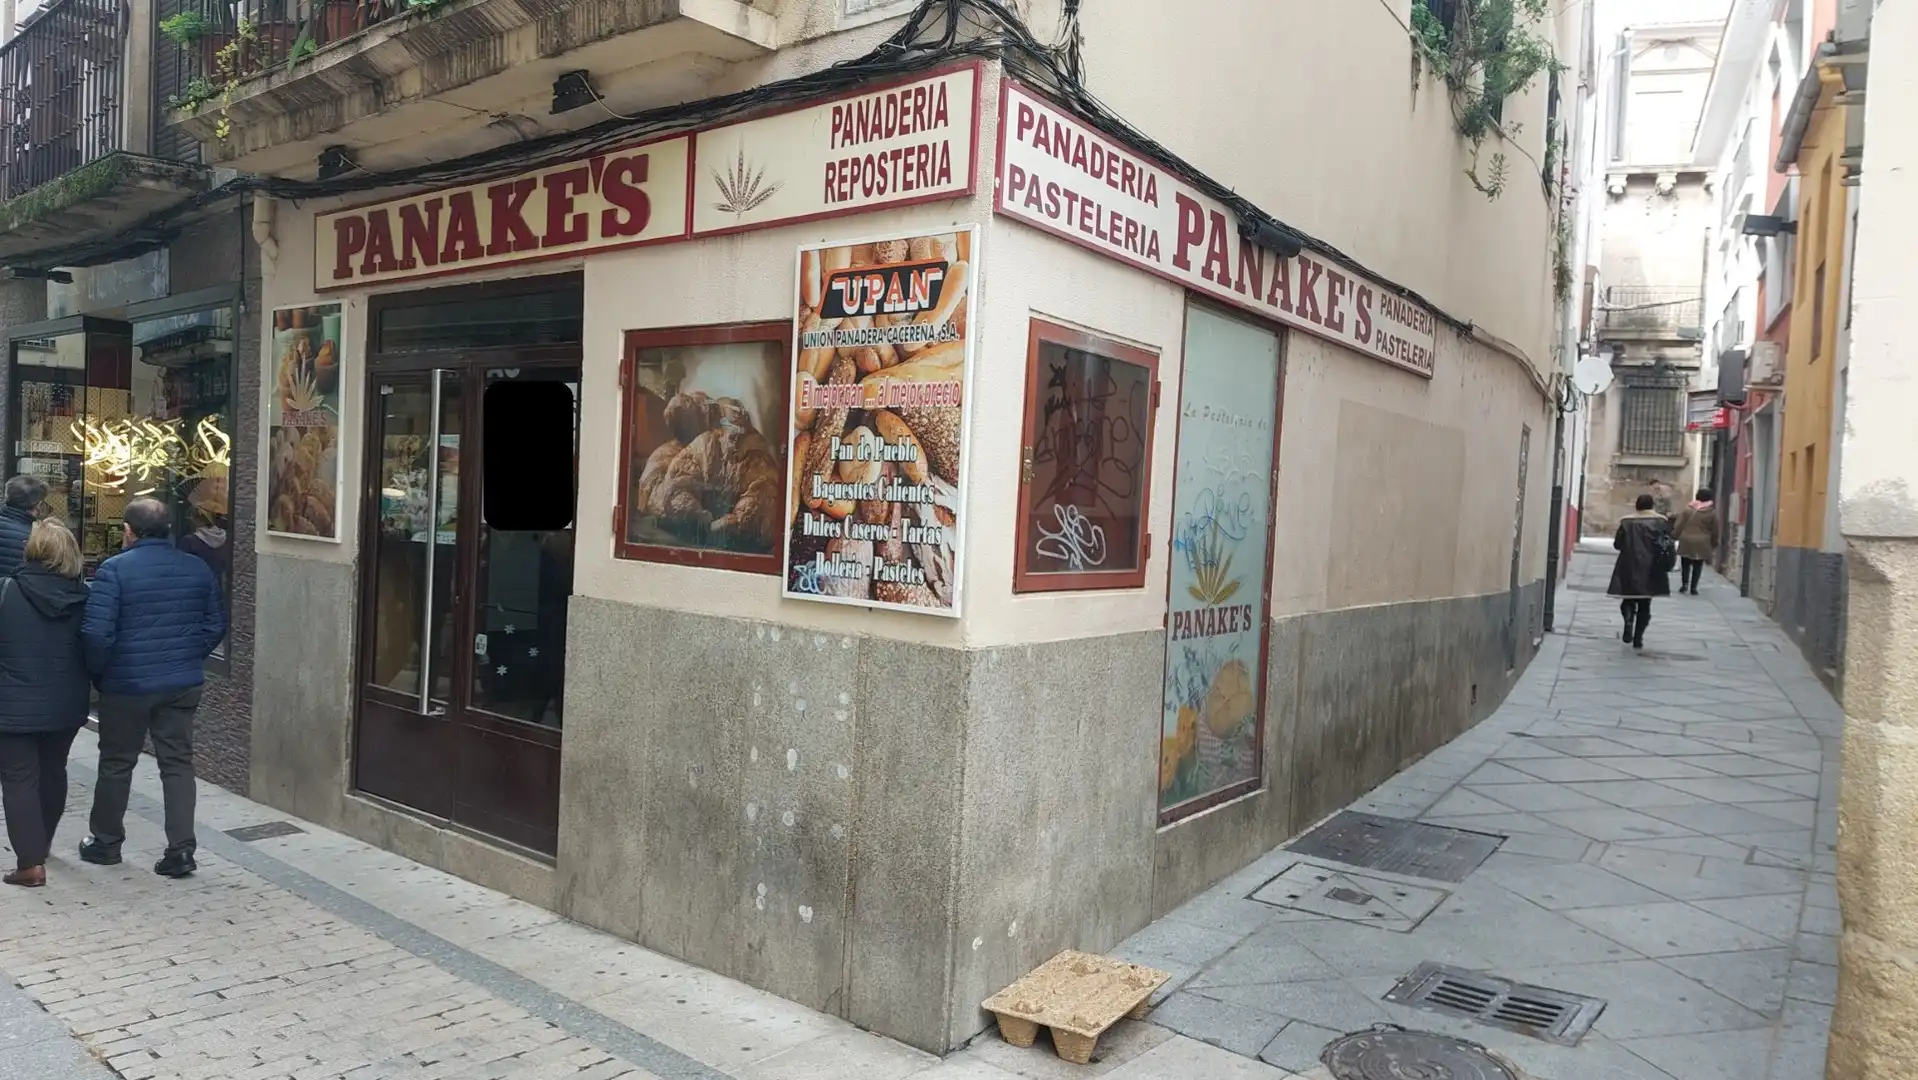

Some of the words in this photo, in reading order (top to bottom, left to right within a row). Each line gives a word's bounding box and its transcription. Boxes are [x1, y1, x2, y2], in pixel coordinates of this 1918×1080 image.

[831, 81, 948, 150] PANADERIA
[824, 140, 951, 204] REPOSTERIA
[1017, 101, 1159, 209] PANADERIA
[333, 153, 651, 279] PANAKE'S
[1008, 163, 1161, 263] PASTELERIA
[1173, 191, 1373, 345] PANAKE'S
[832, 267, 943, 314] UPAN
[1380, 292, 1434, 338] PANADERIA
[803, 331, 834, 348] UNION
[836, 327, 883, 346] PANADERA
[1376, 328, 1433, 369] PASTELERIA
[801, 379, 812, 408] El
[878, 375, 888, 407] al
[924, 373, 960, 412] precio
[830, 435, 853, 460] Pan
[857, 435, 871, 461] de
[874, 435, 917, 461] Pueblo
[878, 475, 935, 504] Calientes
[803, 512, 841, 538] Dulces
[844, 514, 890, 541] Caseros
[901, 518, 943, 545] Tartas
[873, 556, 925, 585] Pasteles
[1172, 604, 1253, 641] PANAKE'S
